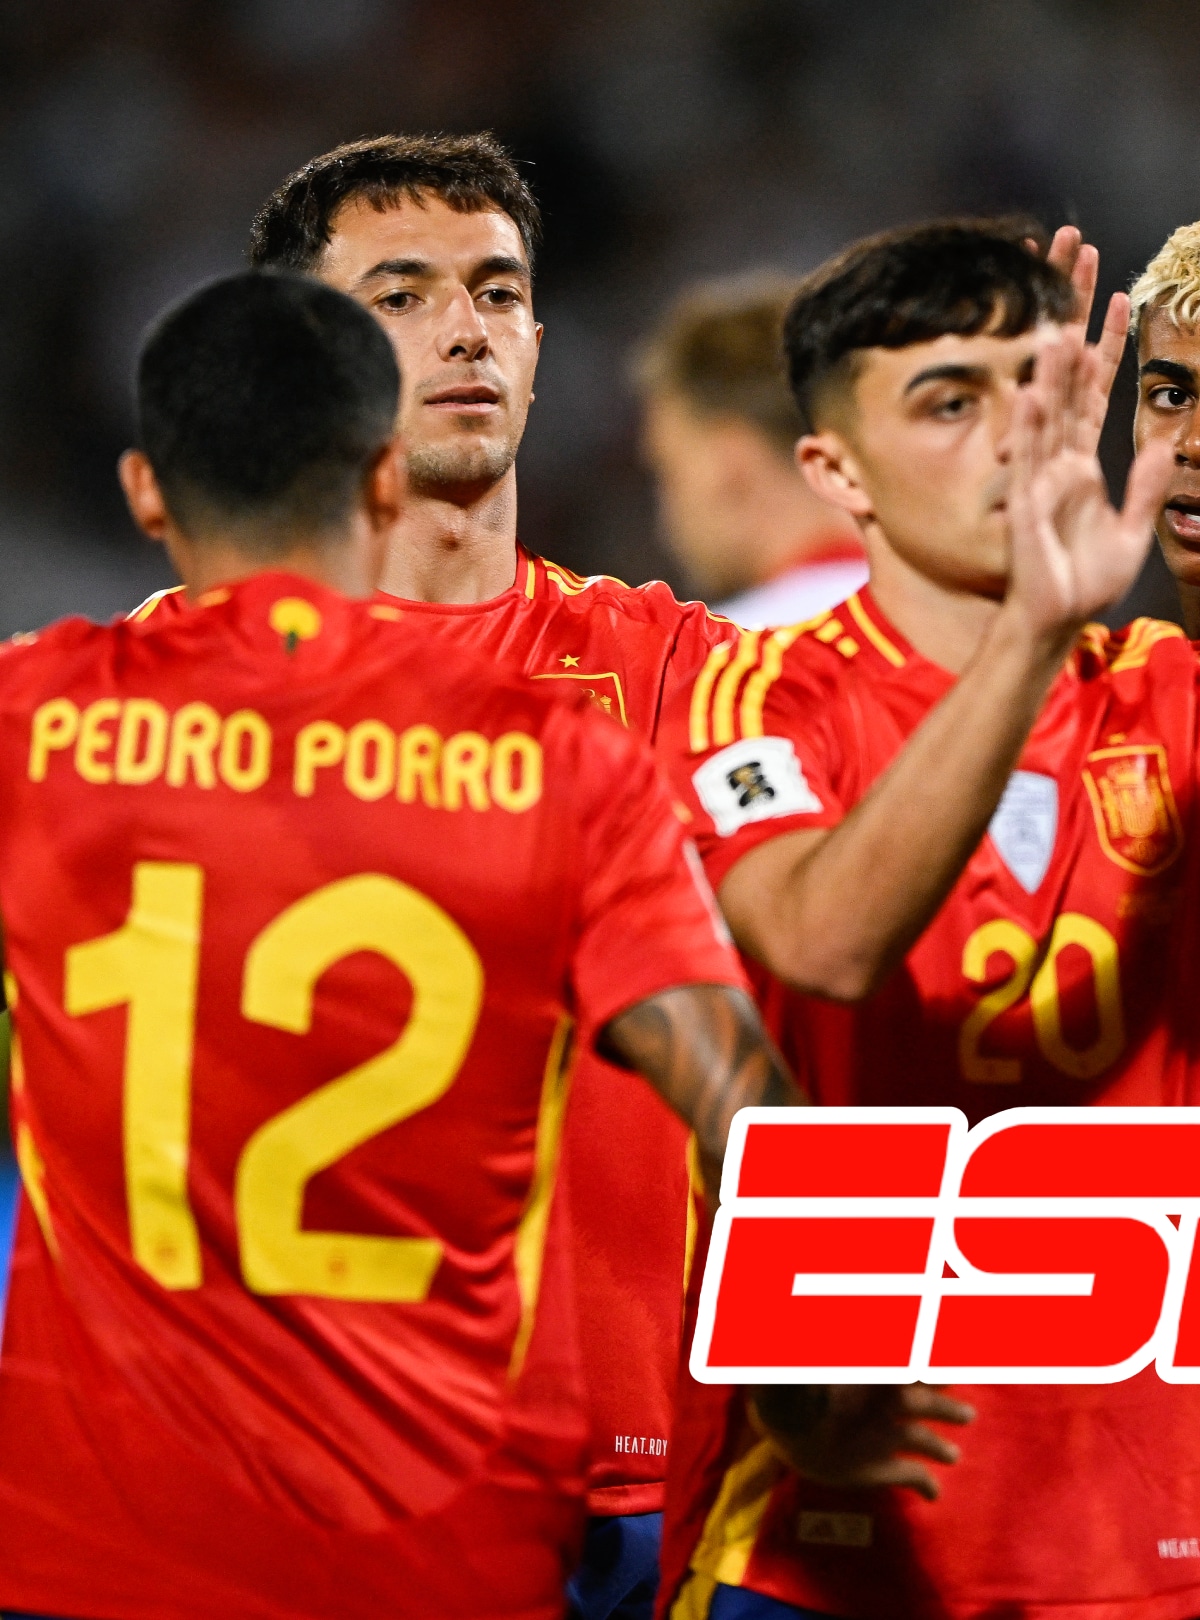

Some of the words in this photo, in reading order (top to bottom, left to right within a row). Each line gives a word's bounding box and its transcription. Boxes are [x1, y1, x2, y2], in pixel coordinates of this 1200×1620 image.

[28, 697, 271, 794] PEDRO
[293, 719, 543, 813] PORRO
[959, 912, 1128, 1085] 20
[63, 863, 485, 1302] 12
[615, 1435, 668, 1457] HEAT.RDY
